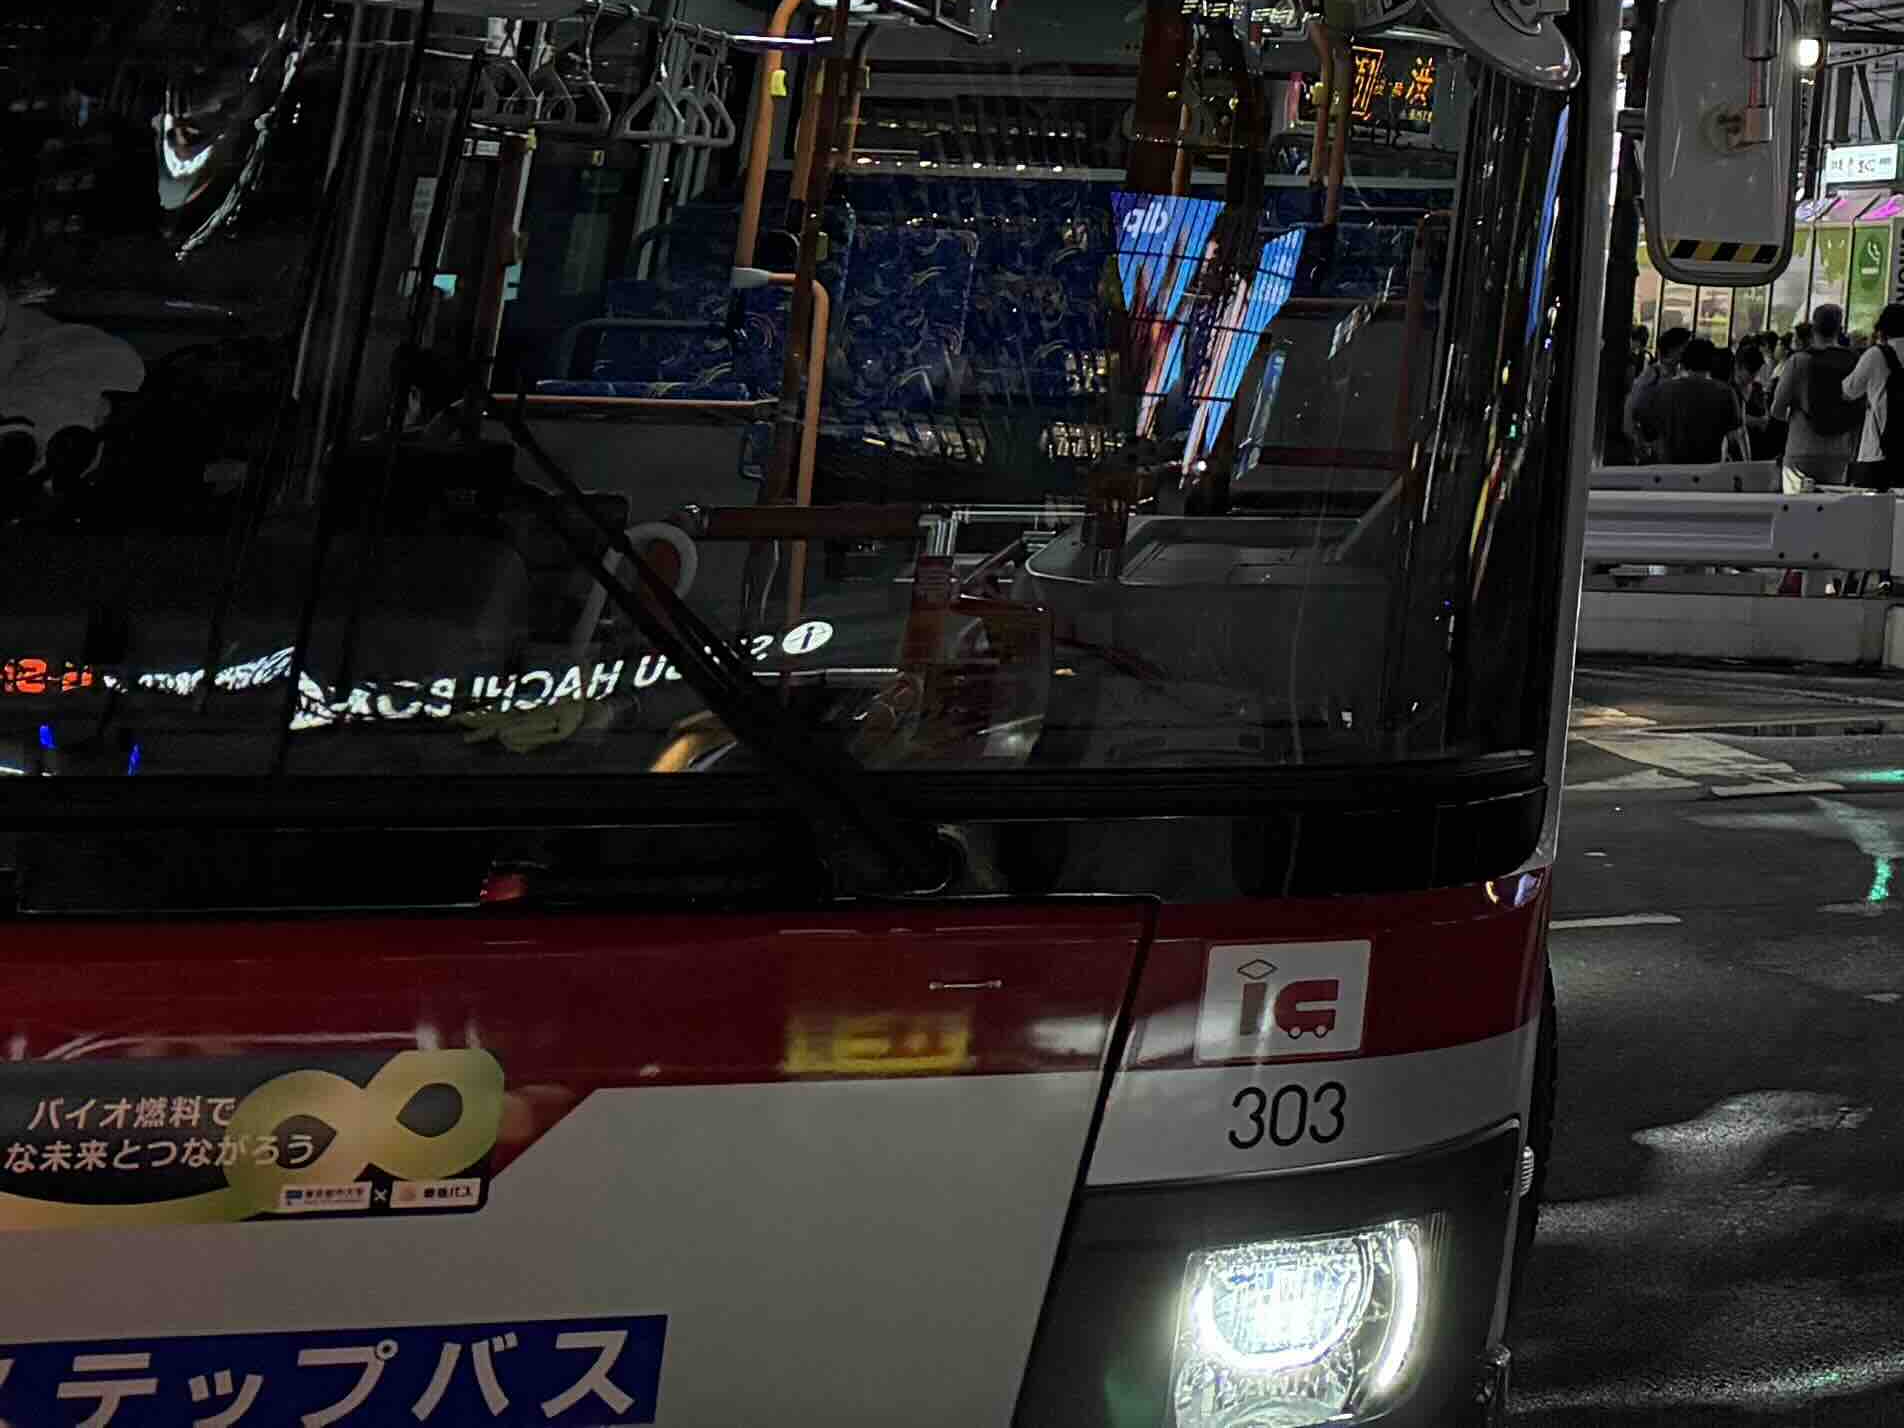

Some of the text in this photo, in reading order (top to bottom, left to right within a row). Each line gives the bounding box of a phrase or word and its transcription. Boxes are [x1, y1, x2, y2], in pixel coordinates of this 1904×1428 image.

[29, 1095, 236, 1130] バイオ燃料で
[1228, 1080, 1348, 1149] 303
[3, 1133, 314, 1174] な未来とつながろう
[0, 1328, 635, 1428] テップバス
